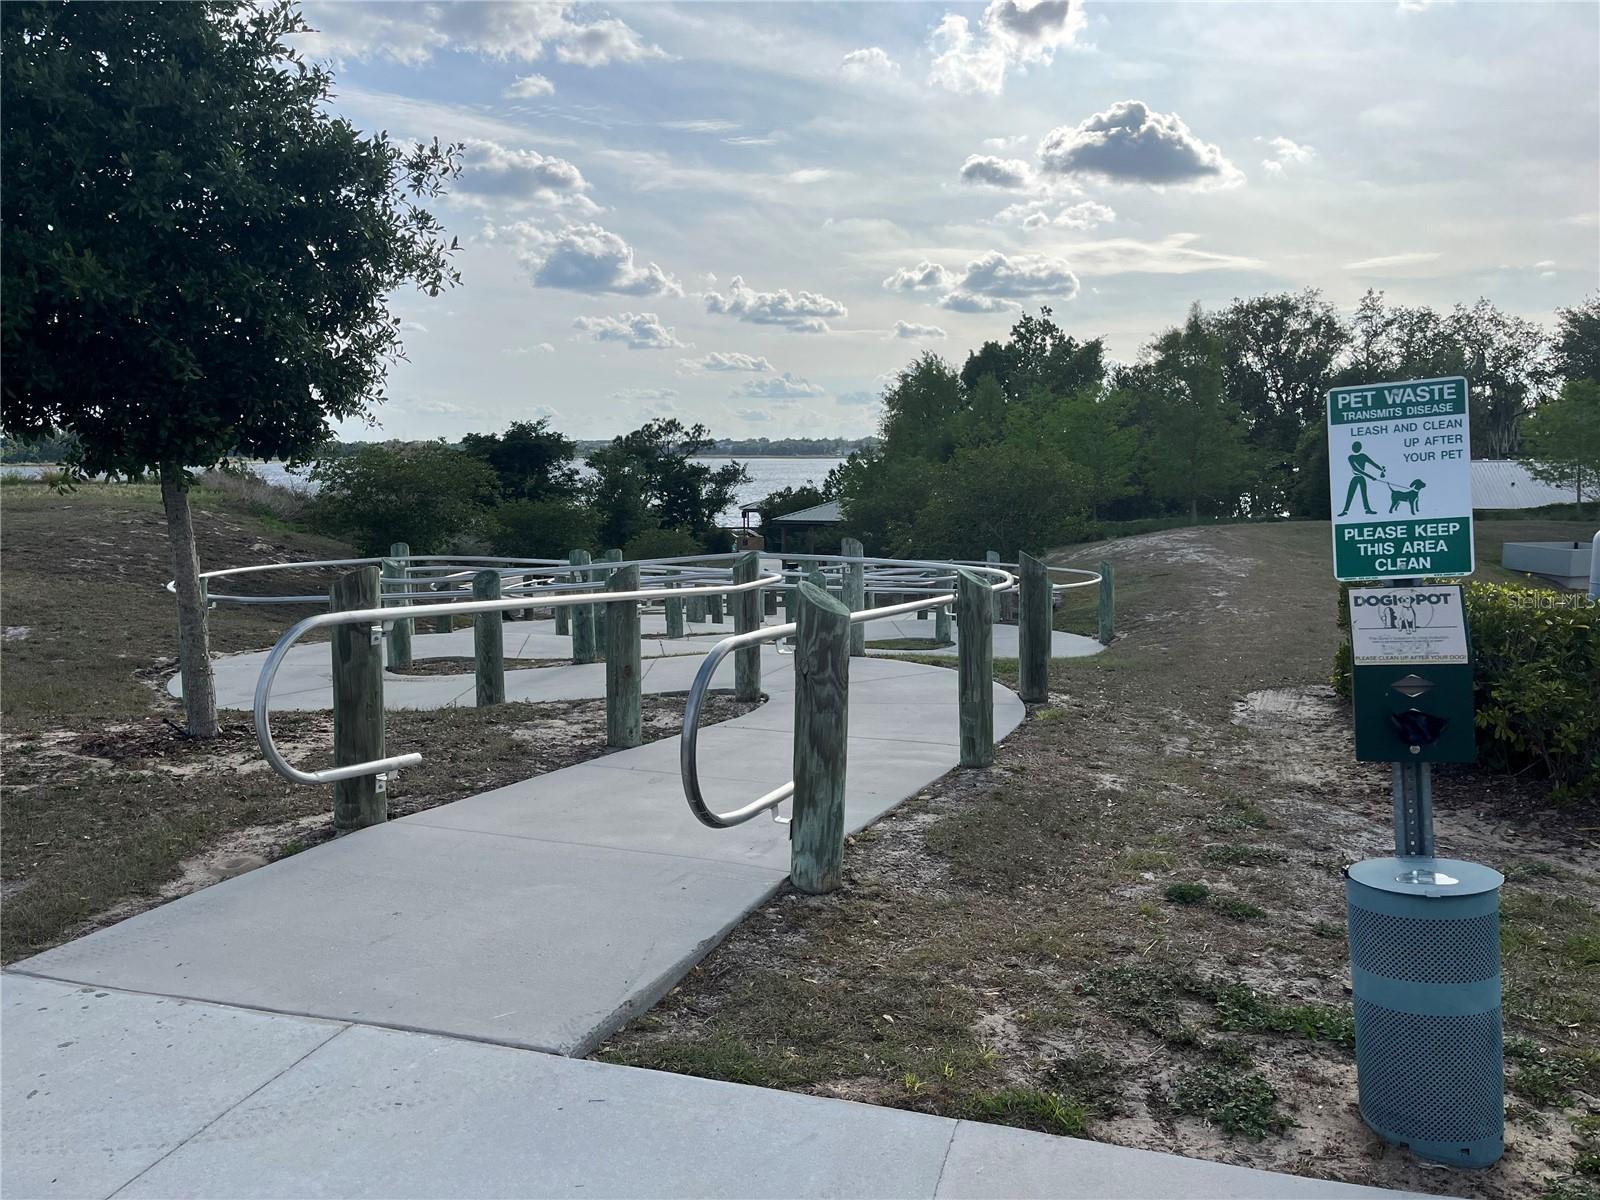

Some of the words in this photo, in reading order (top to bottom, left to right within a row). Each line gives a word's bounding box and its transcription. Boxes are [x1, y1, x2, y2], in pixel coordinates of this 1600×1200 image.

[1337, 391, 1376, 409] PET
[1384, 383, 1457, 405] WASTE
[1342, 407, 1402, 421] TRANSMITS
[1406, 402, 1453, 416] DISEASE
[1350, 424, 1388, 437] LEASH
[1393, 422, 1417, 433] AND
[1423, 418, 1463, 431] CLEAN
[1404, 437, 1420, 448] UP
[1424, 433, 1463, 446] AFTER
[1403, 451, 1436, 463] YOUR
[1441, 449, 1463, 460] PET
[1344, 525, 1408, 541] PLEASE
[1415, 522, 1460, 537] KEEP
[1357, 541, 1395, 556] THIS
[1401, 539, 1448, 554] AREA
[1375, 556, 1431, 571] CLEAN
